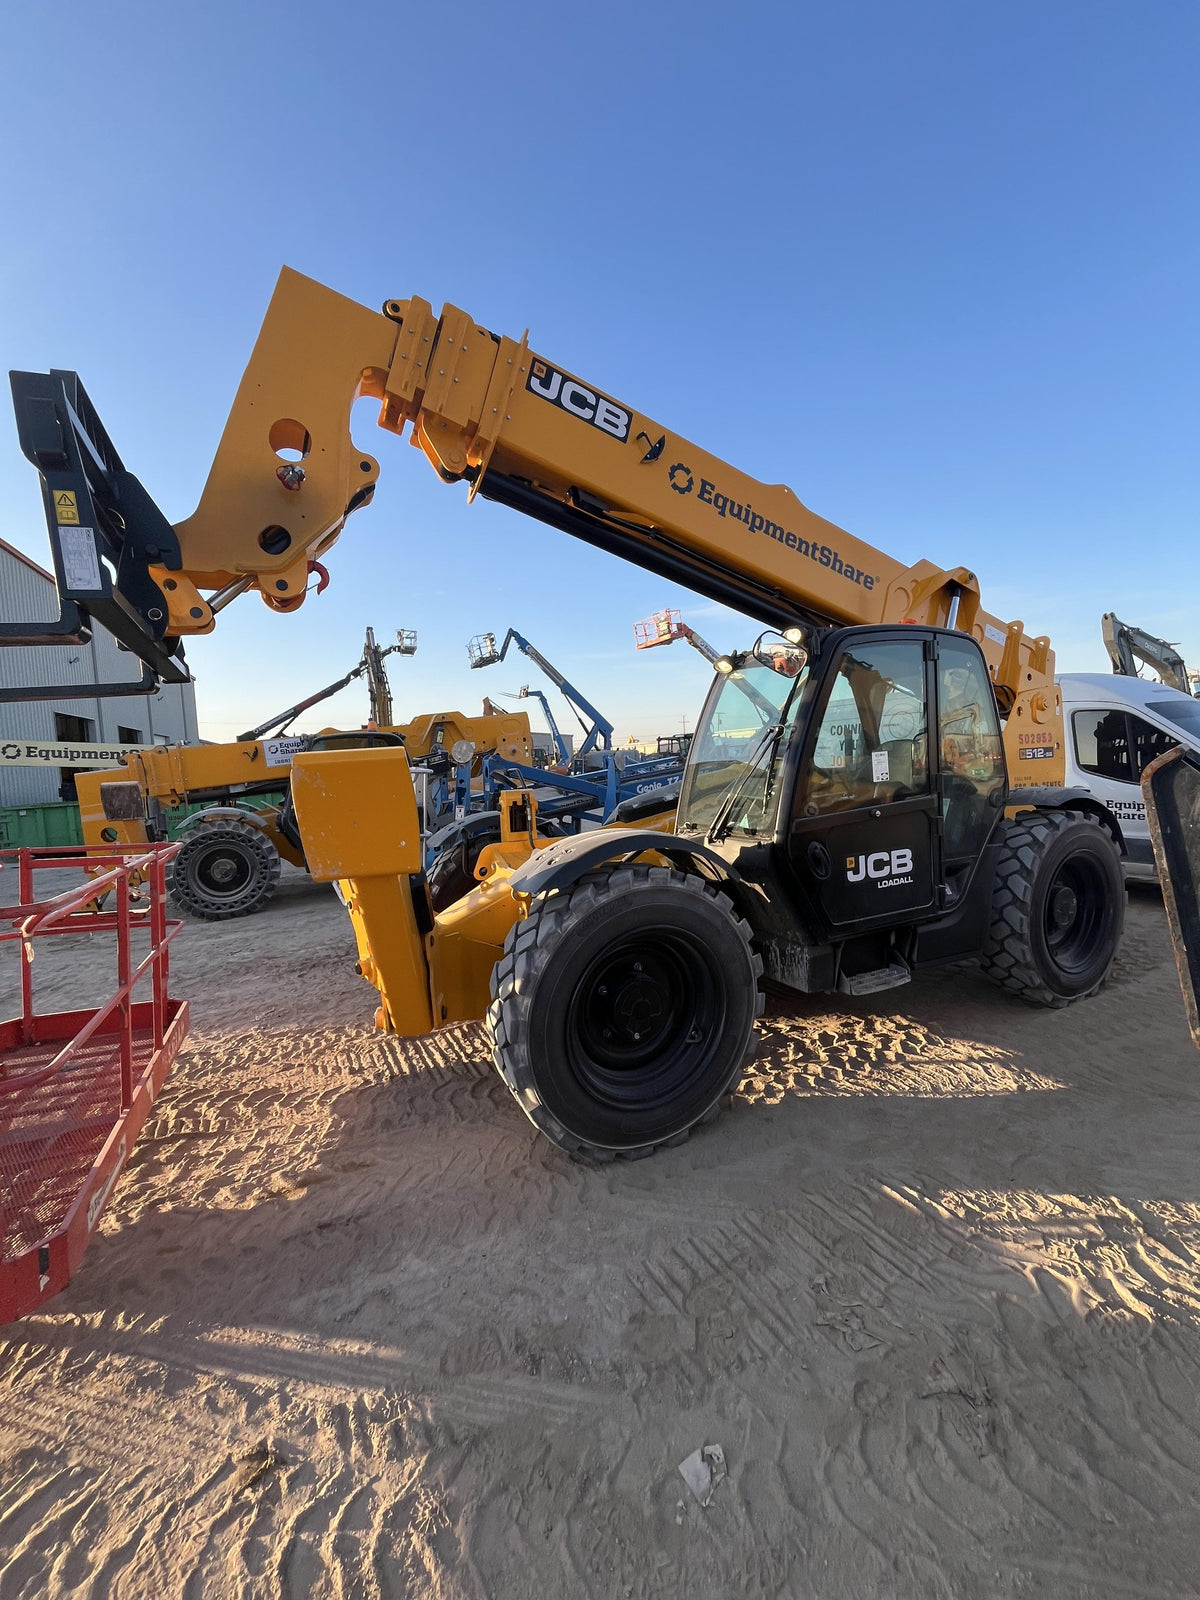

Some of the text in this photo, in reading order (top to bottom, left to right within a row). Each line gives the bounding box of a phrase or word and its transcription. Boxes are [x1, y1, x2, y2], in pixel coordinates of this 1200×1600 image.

[530, 371, 629, 439] JCB
[696, 477, 876, 591] EquipmentShare
[1018, 732, 1053, 745] 502953
[279, 741, 304, 750] Equip
[25, 745, 143, 761] Equipment
[636, 781, 662, 794] Genie
[1105, 799, 1145, 812] Equip
[1114, 810, 1146, 820] hare
[846, 848, 914, 882] JCB
[877, 876, 914, 889] LOADALL
